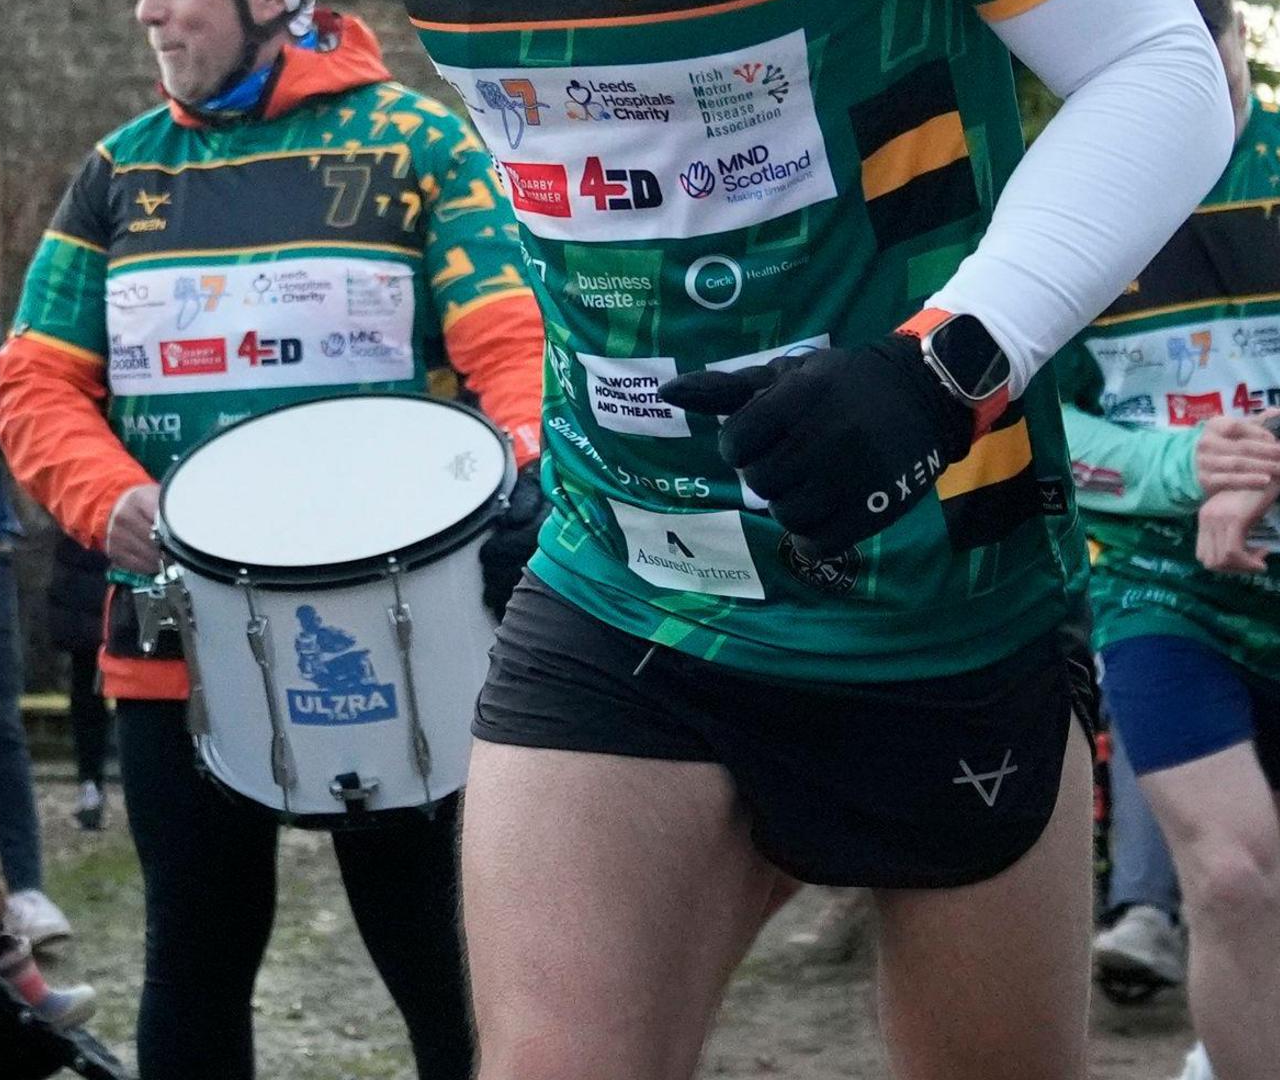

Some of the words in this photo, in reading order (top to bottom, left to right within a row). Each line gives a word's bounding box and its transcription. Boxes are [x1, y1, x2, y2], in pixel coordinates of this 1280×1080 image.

[589, 80, 636, 93] Leeds
[689, 69, 723, 85] Irish
[693, 82, 732, 98] Motor
[697, 90, 754, 110] Neurone
[601, 93, 675, 109] Hospitals
[613, 108, 669, 122] Charity
[702, 103, 755, 124] Disease
[706, 107, 782, 138] Association
[717, 145, 769, 175] MND
[723, 150, 811, 192] Scotland
[579, 156, 664, 211] 4ED
[576, 271, 652, 290] business
[237, 331, 305, 367] 4ED
[598, 401, 618, 414] AND
[620, 405, 673, 419] THEATRE
[867, 449, 941, 513] OXEN
